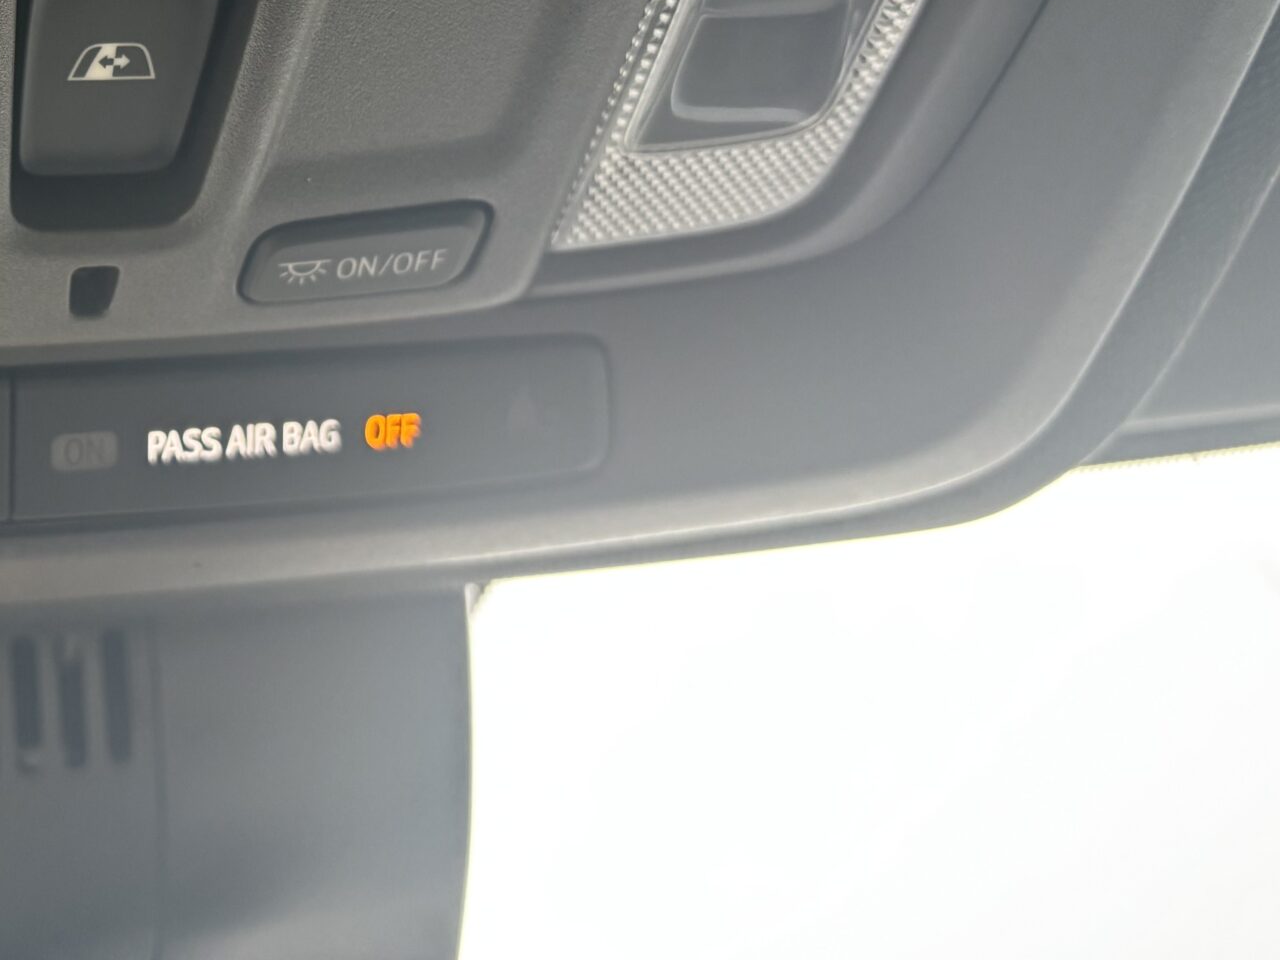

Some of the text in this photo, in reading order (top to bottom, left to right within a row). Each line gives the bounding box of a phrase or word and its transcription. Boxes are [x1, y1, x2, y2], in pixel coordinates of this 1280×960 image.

[336, 248, 449, 279] ON/OFF
[147, 426, 223, 465] PASS
[225, 422, 278, 459] AIR
[282, 418, 342, 456] BAG
[365, 413, 422, 452] OFF
